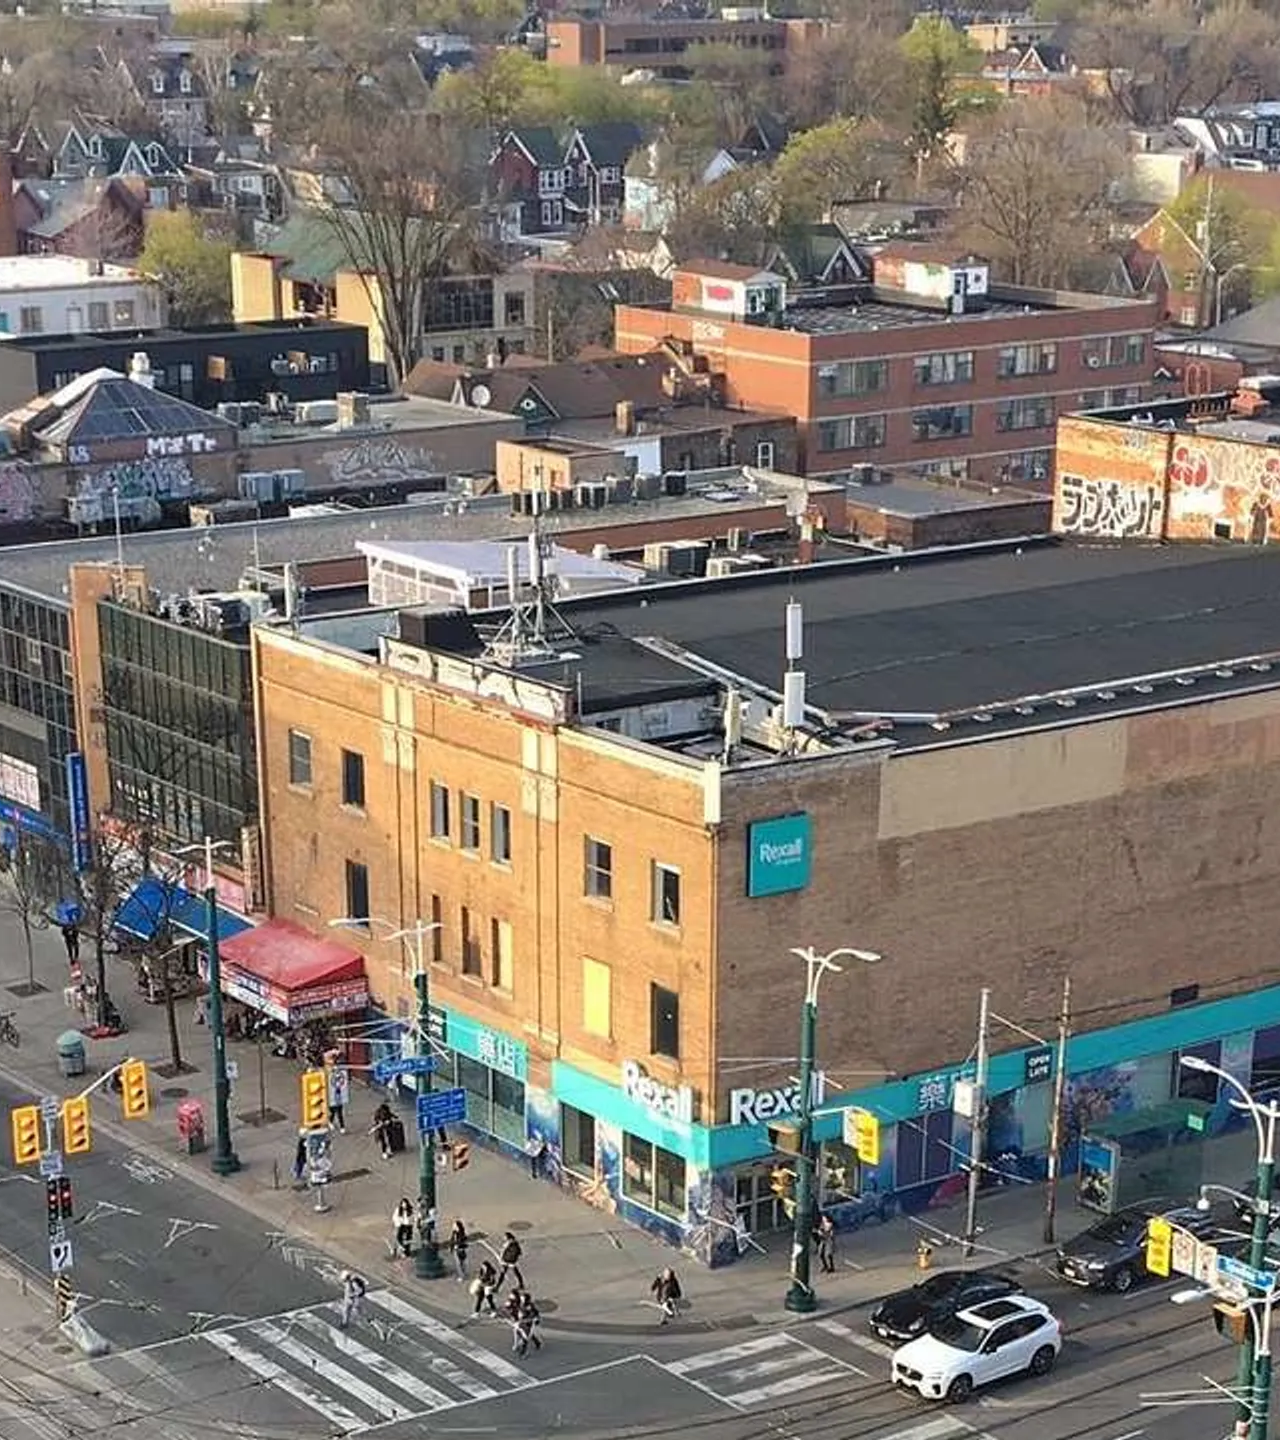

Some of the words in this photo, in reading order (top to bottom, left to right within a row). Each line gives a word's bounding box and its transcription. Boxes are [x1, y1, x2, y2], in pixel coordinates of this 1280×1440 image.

[1028, 1054, 1051, 1067] OPEN
[1028, 1065, 1050, 1078] LATE
[622, 1060, 693, 1124] Rexall
[730, 1070, 826, 1126] Rexall
